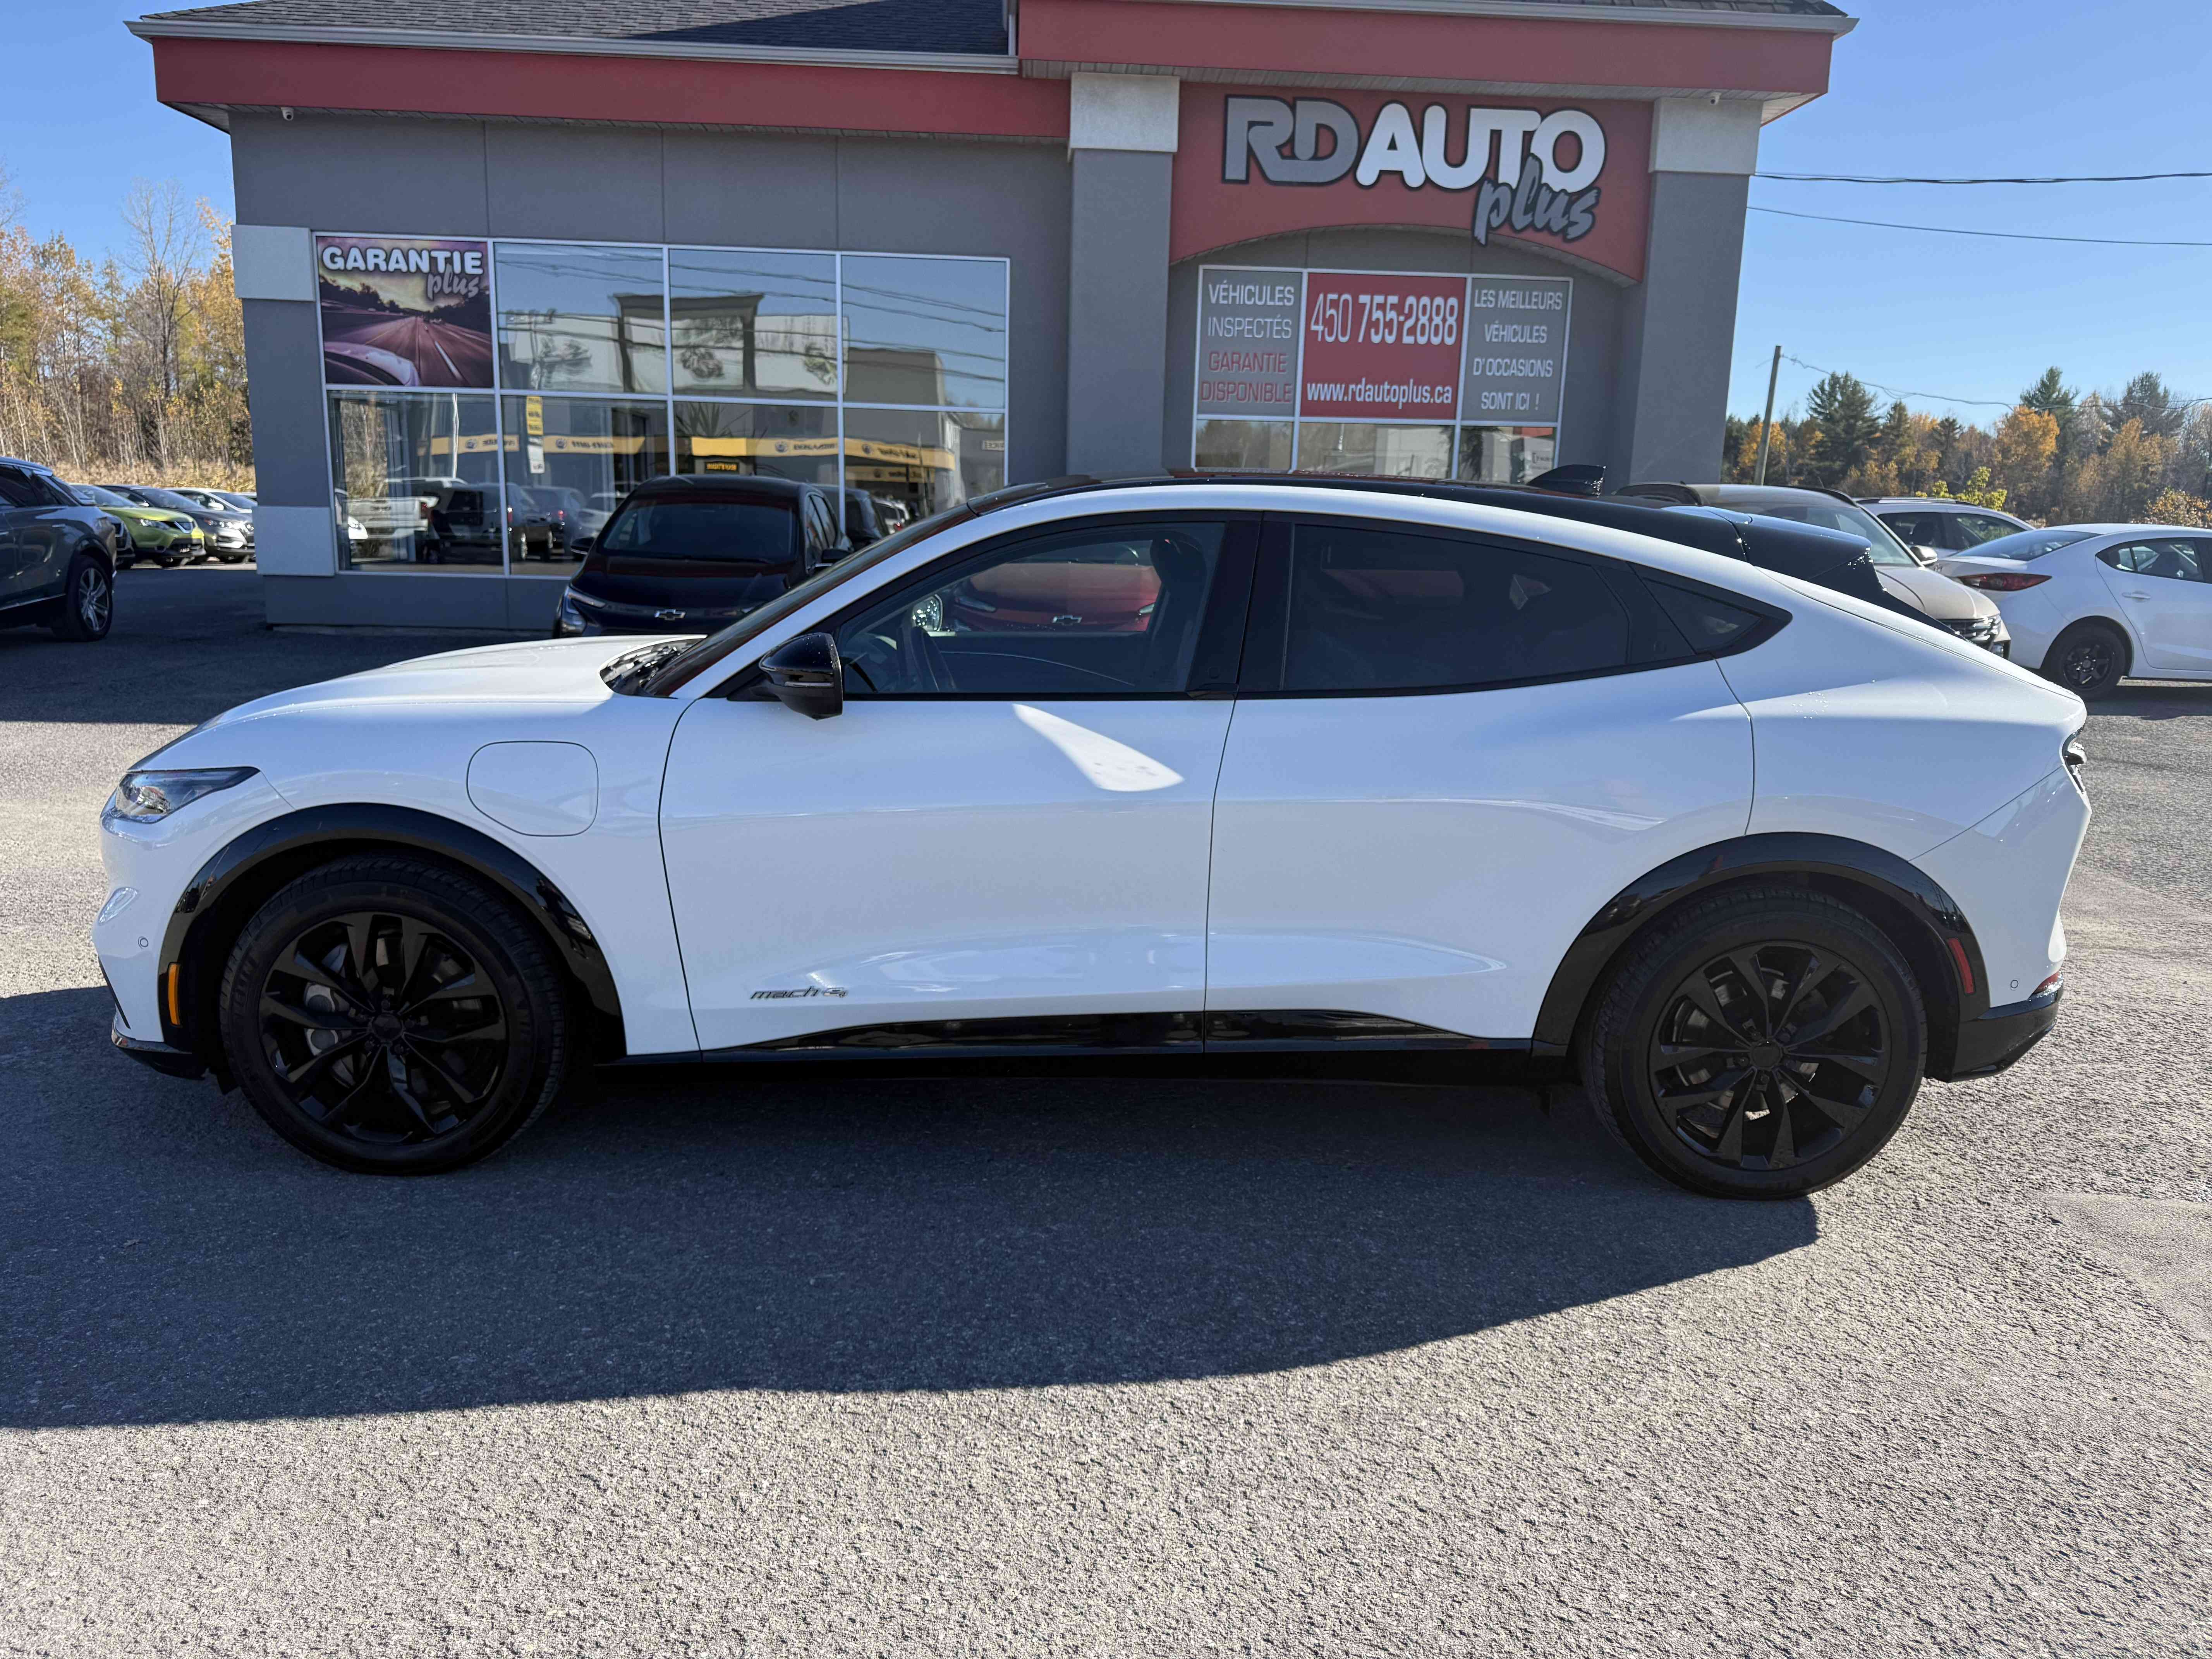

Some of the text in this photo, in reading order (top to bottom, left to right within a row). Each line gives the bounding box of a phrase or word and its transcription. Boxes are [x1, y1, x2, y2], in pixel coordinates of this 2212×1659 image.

[1472, 152, 1601, 246] plus
[322, 246, 483, 275] GARANTIE
[427, 263, 479, 301] plus
[1208, 280, 1295, 306] VÉHICULES
[1474, 289, 1563, 310] LES MEILLEURS
[1207, 314, 1292, 339] INSPECTÉS
[1310, 293, 1459, 345] 450 755-2888
[1484, 320, 1547, 343] VÉHICULES
[1208, 351, 1288, 374] GARANTIE
[1202, 381, 1294, 404] DISPONIBLE
[1307, 377, 1453, 409] www.rdautoplus.ca
[1480, 392, 1513, 410] SONT
[1515, 392, 1530, 410] ICI
